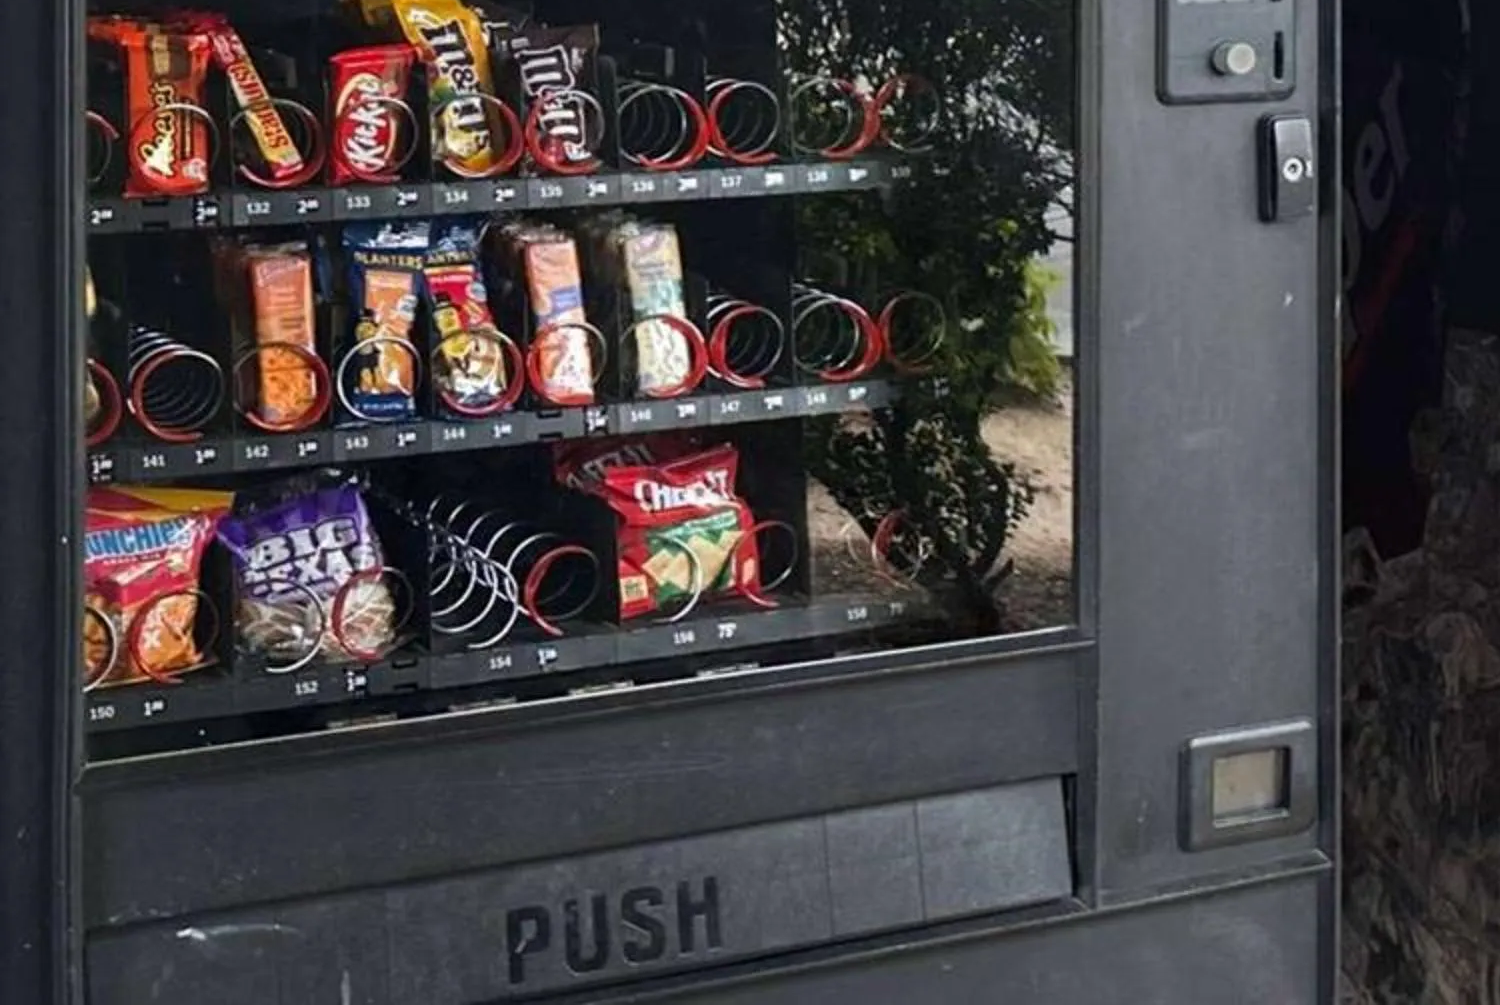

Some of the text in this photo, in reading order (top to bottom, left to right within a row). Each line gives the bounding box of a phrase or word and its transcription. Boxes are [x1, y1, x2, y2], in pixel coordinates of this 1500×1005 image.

[346, 196, 371, 209] 133
[443, 190, 469, 204] 134
[246, 199, 271, 213] 132
[244, 445, 270, 460] 142
[141, 455, 166, 469] 141
[247, 517, 360, 569] BIG
[295, 680, 320, 695] 152
[89, 705, 116, 720] 150
[505, 874, 725, 983] PUSH
